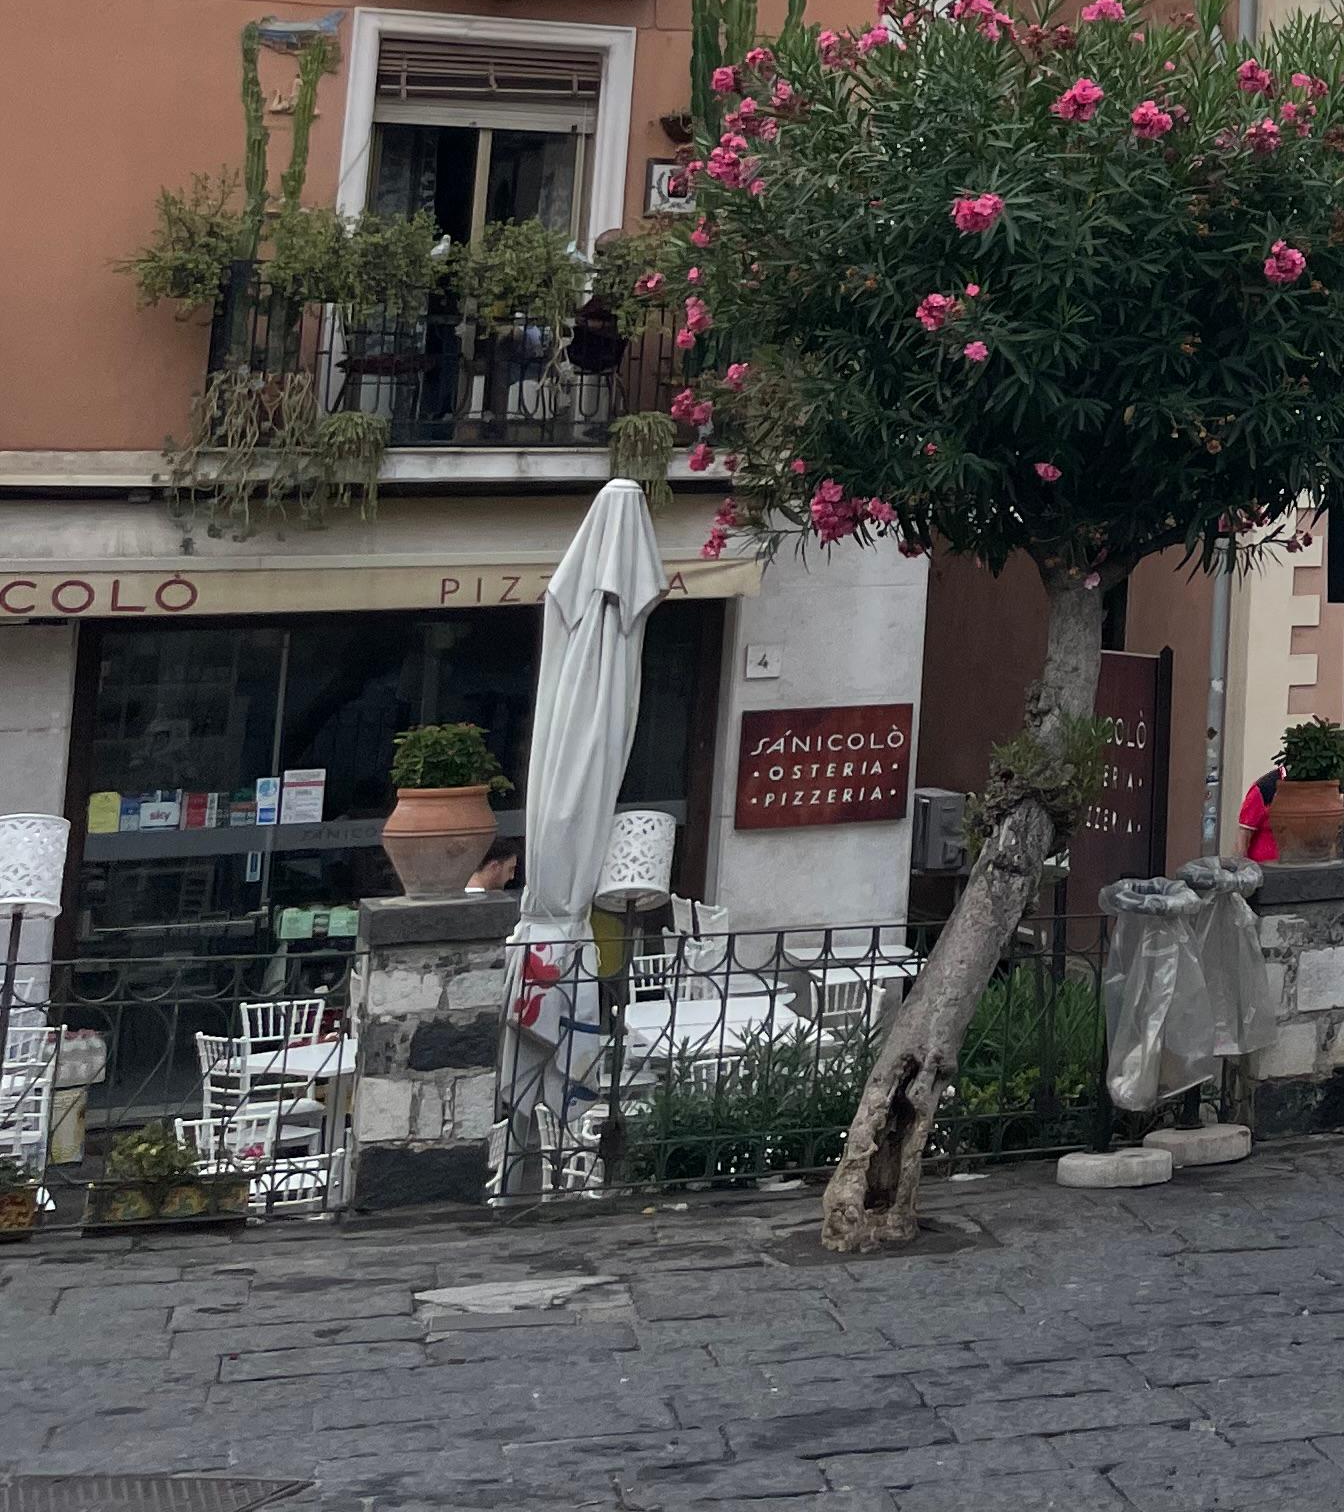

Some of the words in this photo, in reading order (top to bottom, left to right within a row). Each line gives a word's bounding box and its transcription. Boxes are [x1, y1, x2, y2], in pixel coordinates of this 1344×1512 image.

[757, 653, 769, 670] 4
[768, 759, 883, 781] OSTERIA
[763, 786, 883, 808] PIZZERIA
[149, 807, 171, 823] sky
